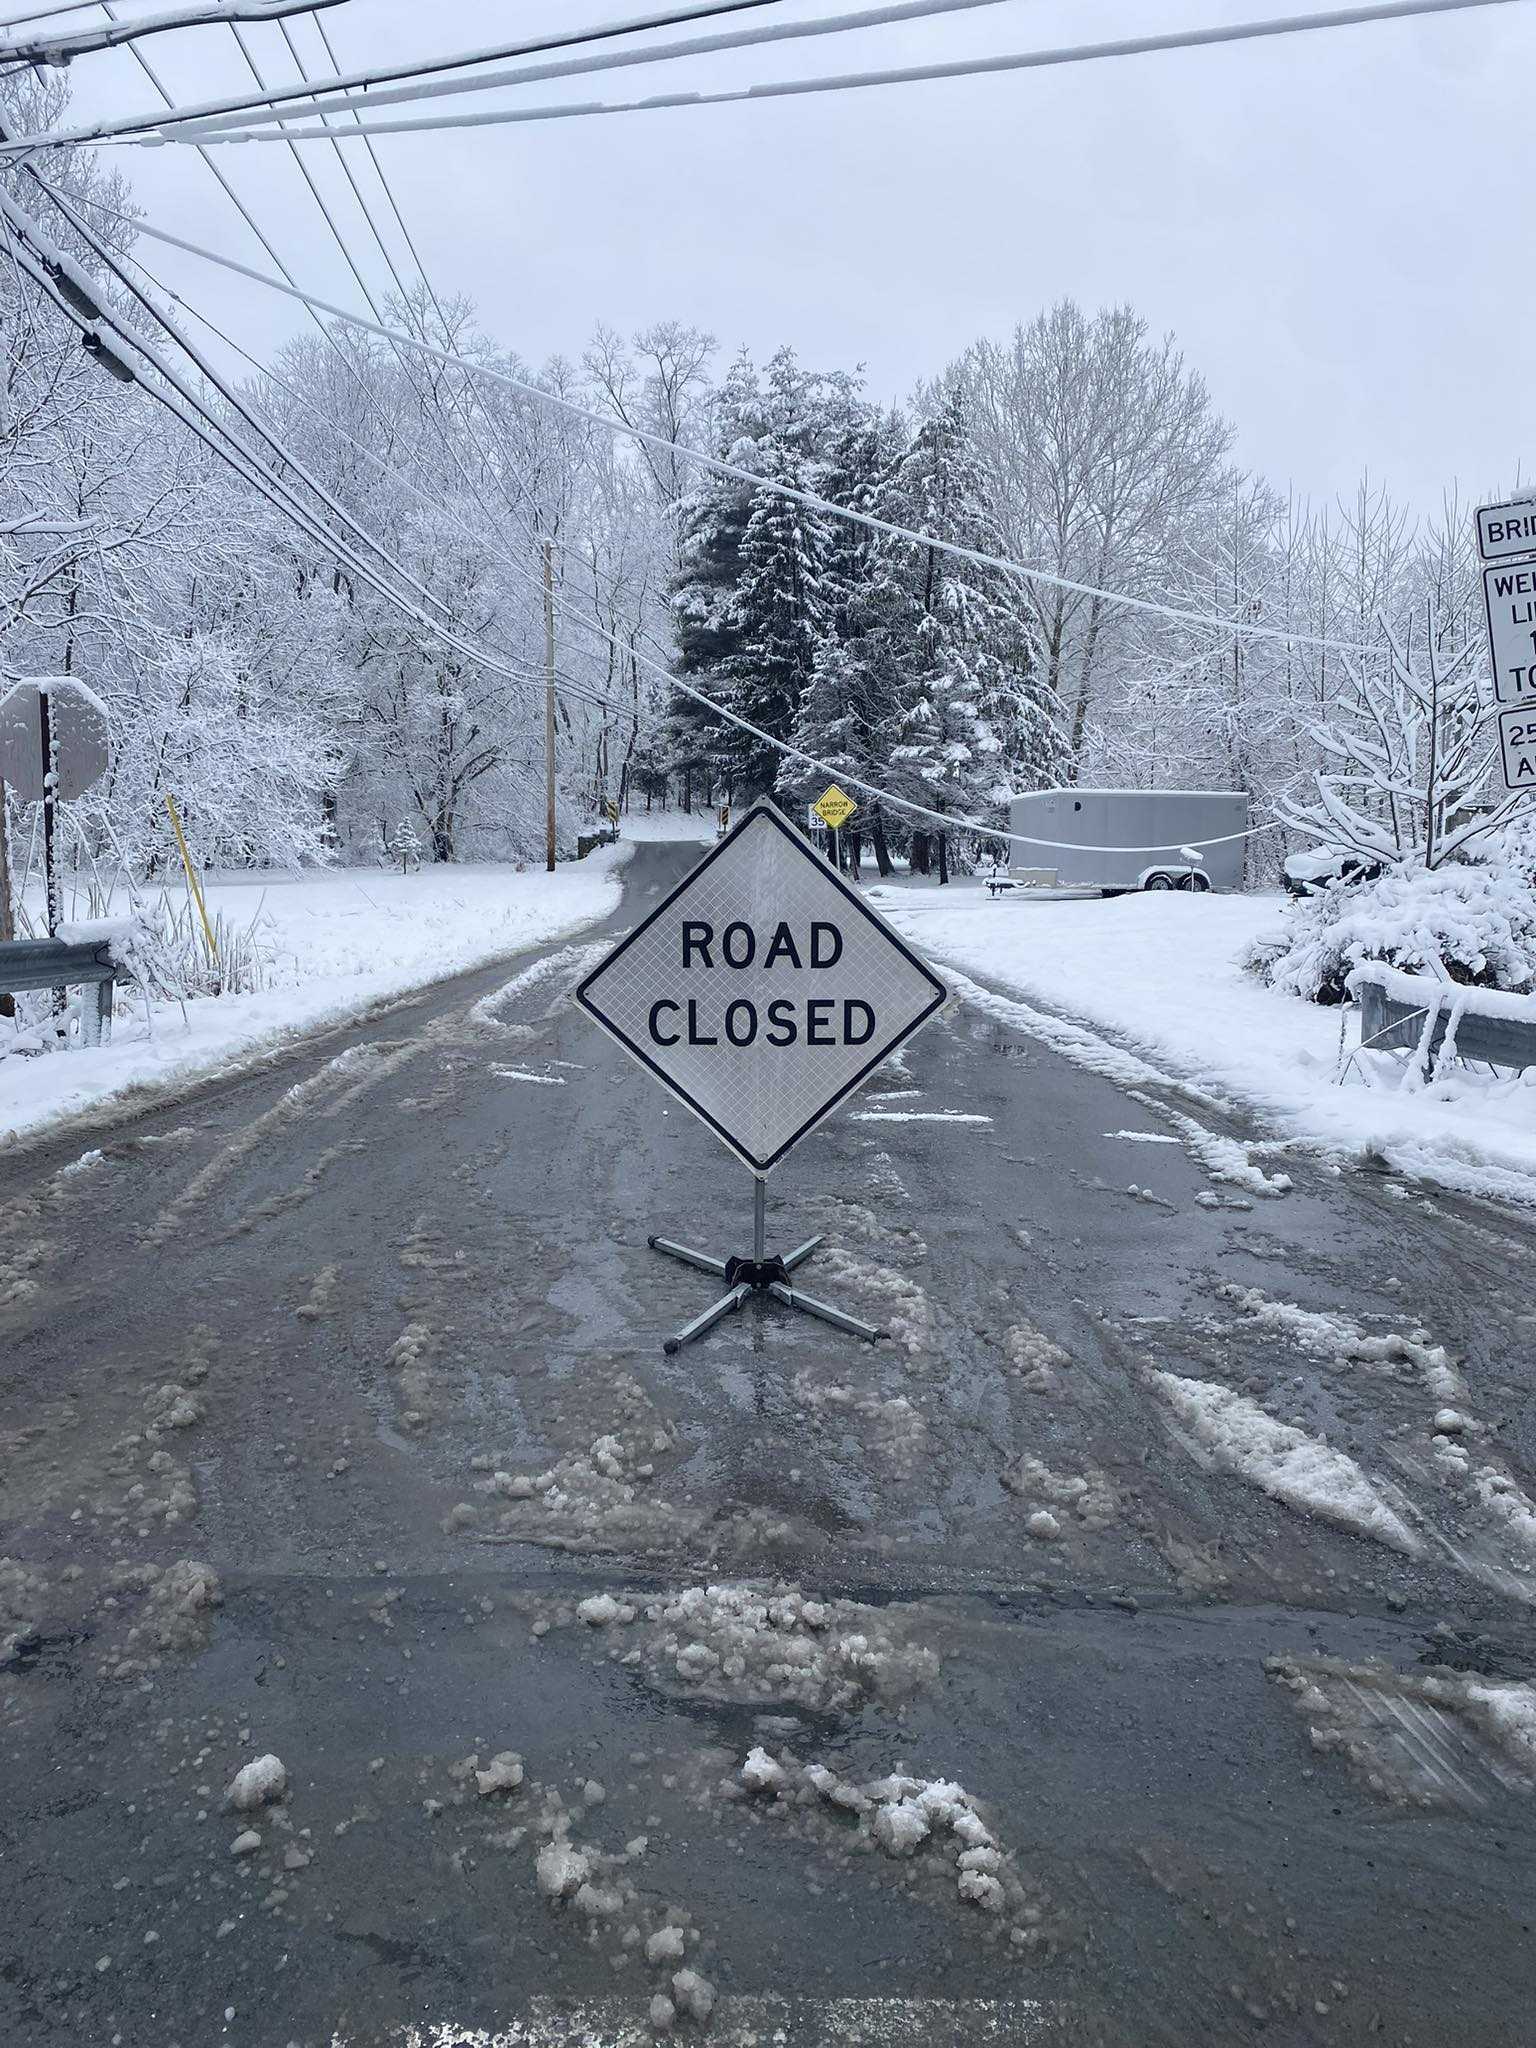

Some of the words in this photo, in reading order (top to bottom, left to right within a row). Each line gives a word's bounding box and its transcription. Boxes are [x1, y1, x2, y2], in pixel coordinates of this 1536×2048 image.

[1511, 601, 1536, 624] LI
[820, 801, 848, 809] NARROW
[811, 817, 825, 826] 35
[681, 921, 844, 969] ROAD
[648, 998, 876, 1047] CLOSED
